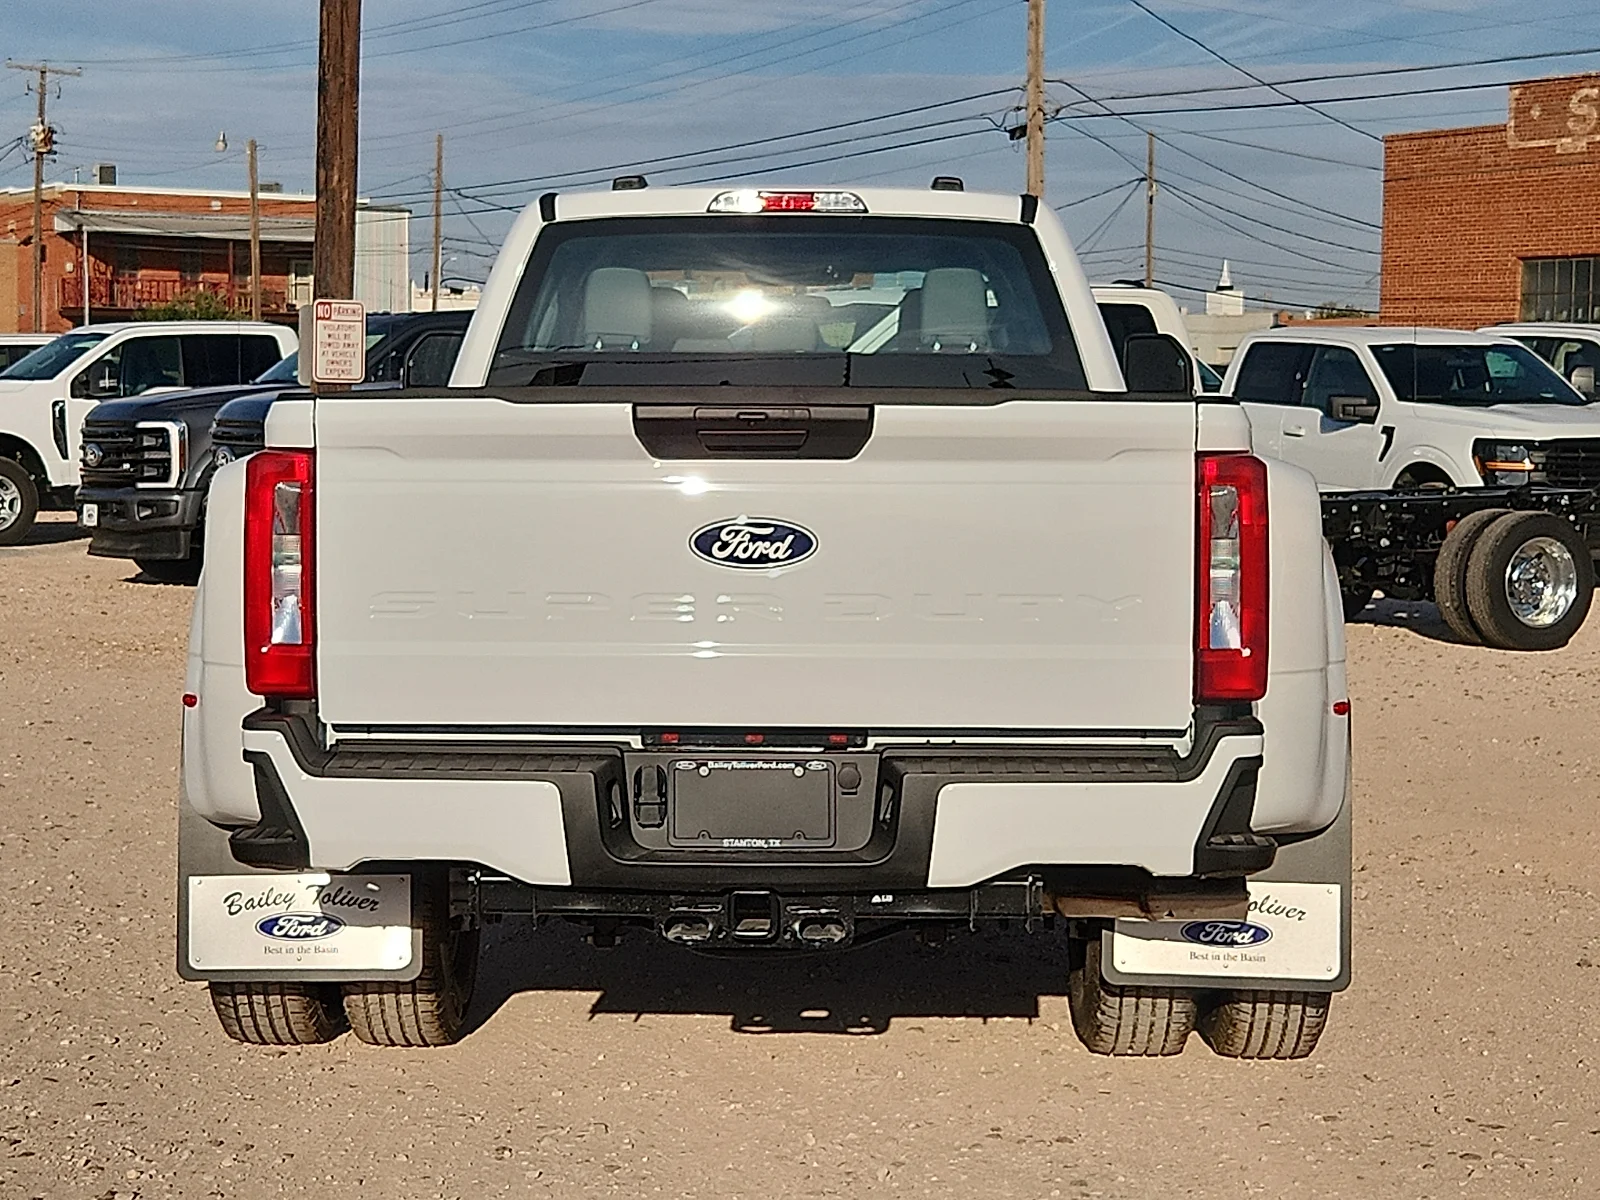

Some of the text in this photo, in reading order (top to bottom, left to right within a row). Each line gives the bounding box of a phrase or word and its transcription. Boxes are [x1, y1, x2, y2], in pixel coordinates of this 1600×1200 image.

[317, 304, 360, 318] NO PARKING
[320, 341, 340, 349] TOWED
[331, 350, 356, 358] VEHICLE
[325, 367, 352, 375] EXPENSE
[711, 525, 795, 559] Ford
[369, 590, 1142, 623] SUPER DUTY
[707, 761, 796, 771] BaileyToliverFord.com
[722, 838, 781, 848] STANTON, TX
[223, 885, 380, 916] Bailey Toliver
[1247, 894, 1307, 921] oliver
[272, 915, 328, 936] Ford
[1199, 922, 1255, 944] Ford
[263, 945, 339, 954] Best in the Basin
[1189, 951, 1267, 963] Best in the Basin
